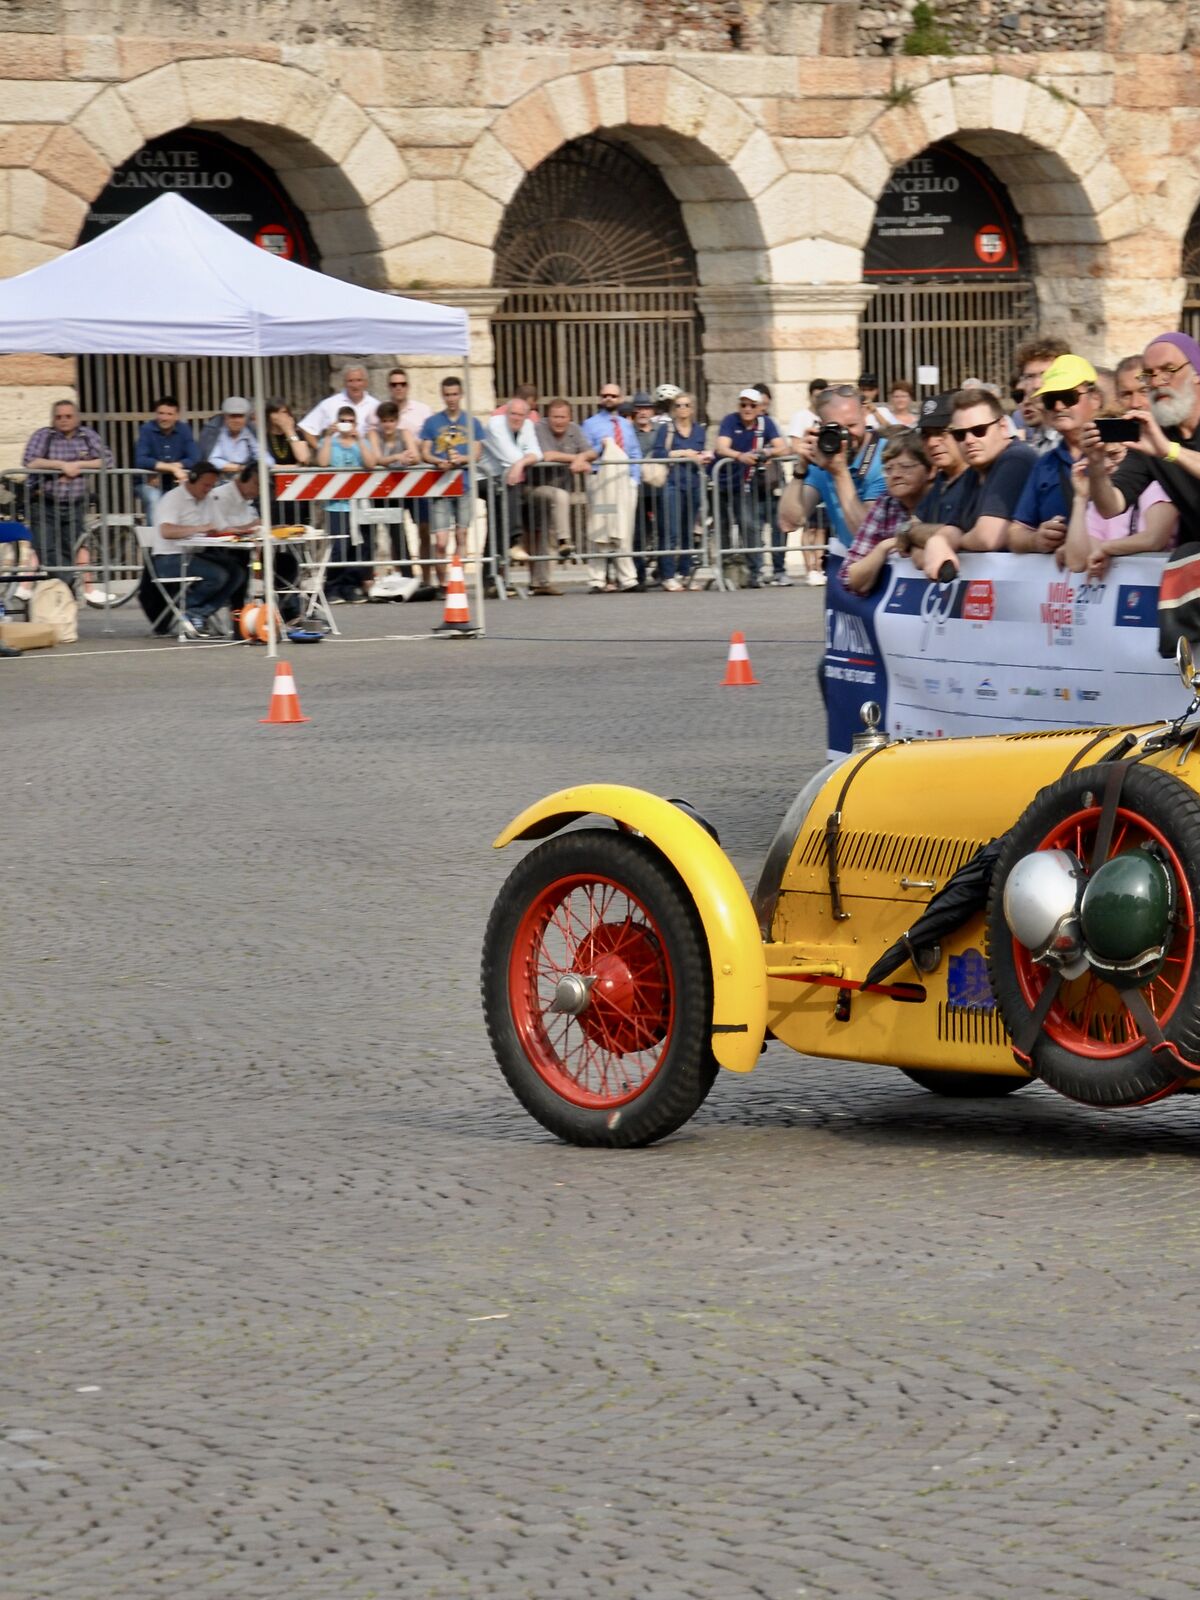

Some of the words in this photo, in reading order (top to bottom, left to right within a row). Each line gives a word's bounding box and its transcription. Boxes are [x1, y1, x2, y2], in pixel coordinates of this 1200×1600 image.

[135, 150, 199, 168] GATE
[896, 158, 935, 175] ATE
[110, 171, 233, 189] CANCELLO
[884, 177, 960, 193] NCELLO
[903, 196, 920, 212] 15
